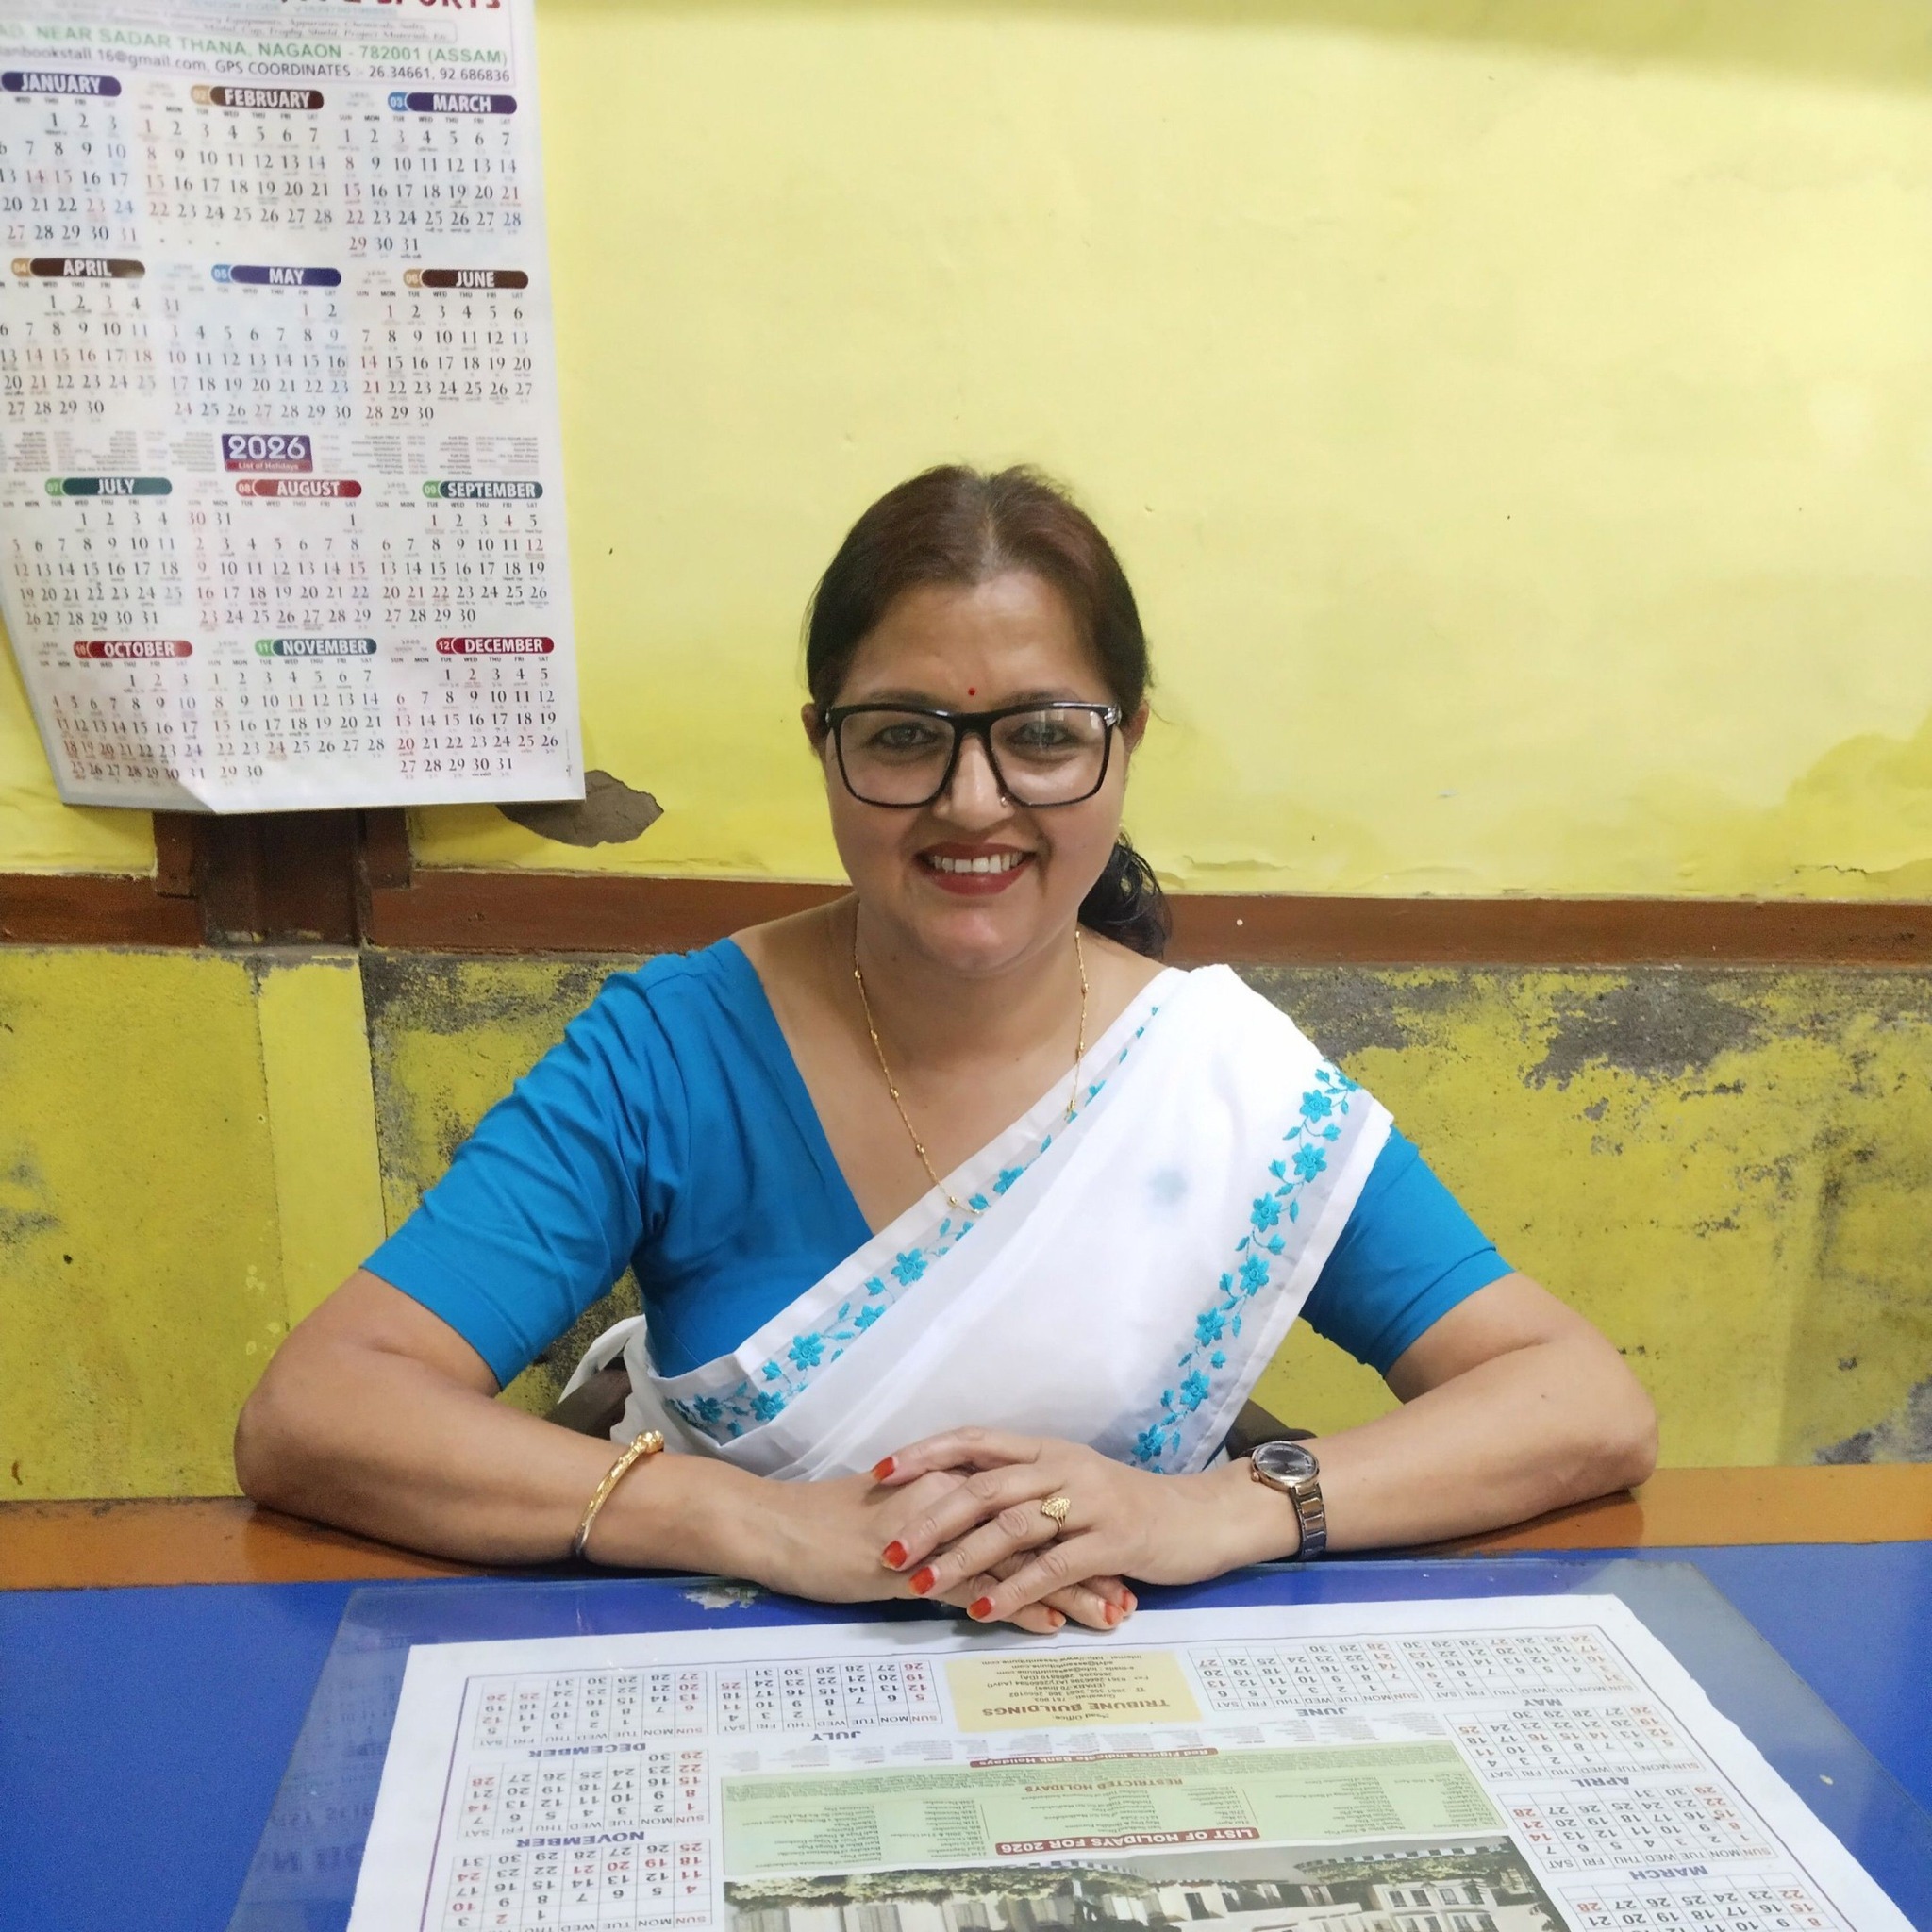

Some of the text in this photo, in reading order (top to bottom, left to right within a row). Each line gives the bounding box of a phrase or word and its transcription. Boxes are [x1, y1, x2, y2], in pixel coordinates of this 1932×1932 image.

[36, 26, 92, 41] NEAR
[100, 28, 171, 49] SADAR
[259, 43, 341, 58] NAGAON
[361, 46, 421, 60] 782001
[429, 48, 508, 65] (ASSAM)
[215, 60, 242, 75] GPS
[249, 62, 350, 77] COORDINATES
[21, 75, 101, 93] JANUARY
[225, 89, 310, 108] FEBRUARY
[391, 94, 491, 112] 03 MARCH
[344, 129, 509, 146] 1 2 3 4 5 6 7
[147, 175, 328, 197] 15 16 17 18 19 20 21
[349, 236, 418, 251] 29 30 31
[64, 260, 112, 276] APRIL
[214, 268, 305, 284] 05 MAY
[456, 272, 495, 287] JUNE
[362, 330, 528, 345] 7 8 9 10 11 12 13
[8, 401, 104, 415] 27 28 29 30
[366, 407, 434, 419] 28 29 30
[228, 436, 305, 459] 2026
[265, 462, 298, 471] Holidays
[98, 479, 134, 494] JULY
[239, 482, 340, 496] 08 AUGUST
[425, 482, 536, 498] 09 SEPTEMBER
[381, 562, 544, 575] 13 14 15 16 17 18 19
[26, 611, 158, 625] 26 27 28 29 30 31
[104, 642, 175, 657] OCTOBER
[258, 640, 368, 655] 11 NOVEMBER
[440, 640, 543, 652] 12 DECEMBER
[396, 712, 556, 726] 13 14 15 16 17 18 19
[221, 766, 263, 778] 29 30
[982, 1699, 1169, 1716] TRIBUNE BUILDINGS
[1524, 1698, 1562, 1707] MAY
[1295, 1707, 1347, 1716] JUNE
[811, 1731, 861, 1741] JULY
[528, 1743, 645, 1757] DECEMBER
[1075, 1753, 1128, 1761] Indicate
[1132, 1750, 1179, 1758] Figures
[979, 1758, 1035, 1767] Holidays
[1024, 1778, 1182, 1792] RESTRICTED HOLIDAYS
[1571, 1777, 1630, 1787] APRIL
[569, 1822, 602, 1830] WED
[516, 1831, 644, 1848] NOVEMBER
[1001, 1828, 1253, 1854] LIST OF HOLIDAYS FOR 2026
[457, 1857, 702, 1881] 18 19 20 21 22 23 24
[1629, 1865, 1708, 1880] MARCH
[1577, 1890, 1801, 1912] 22 23 24 25 26 27 28
